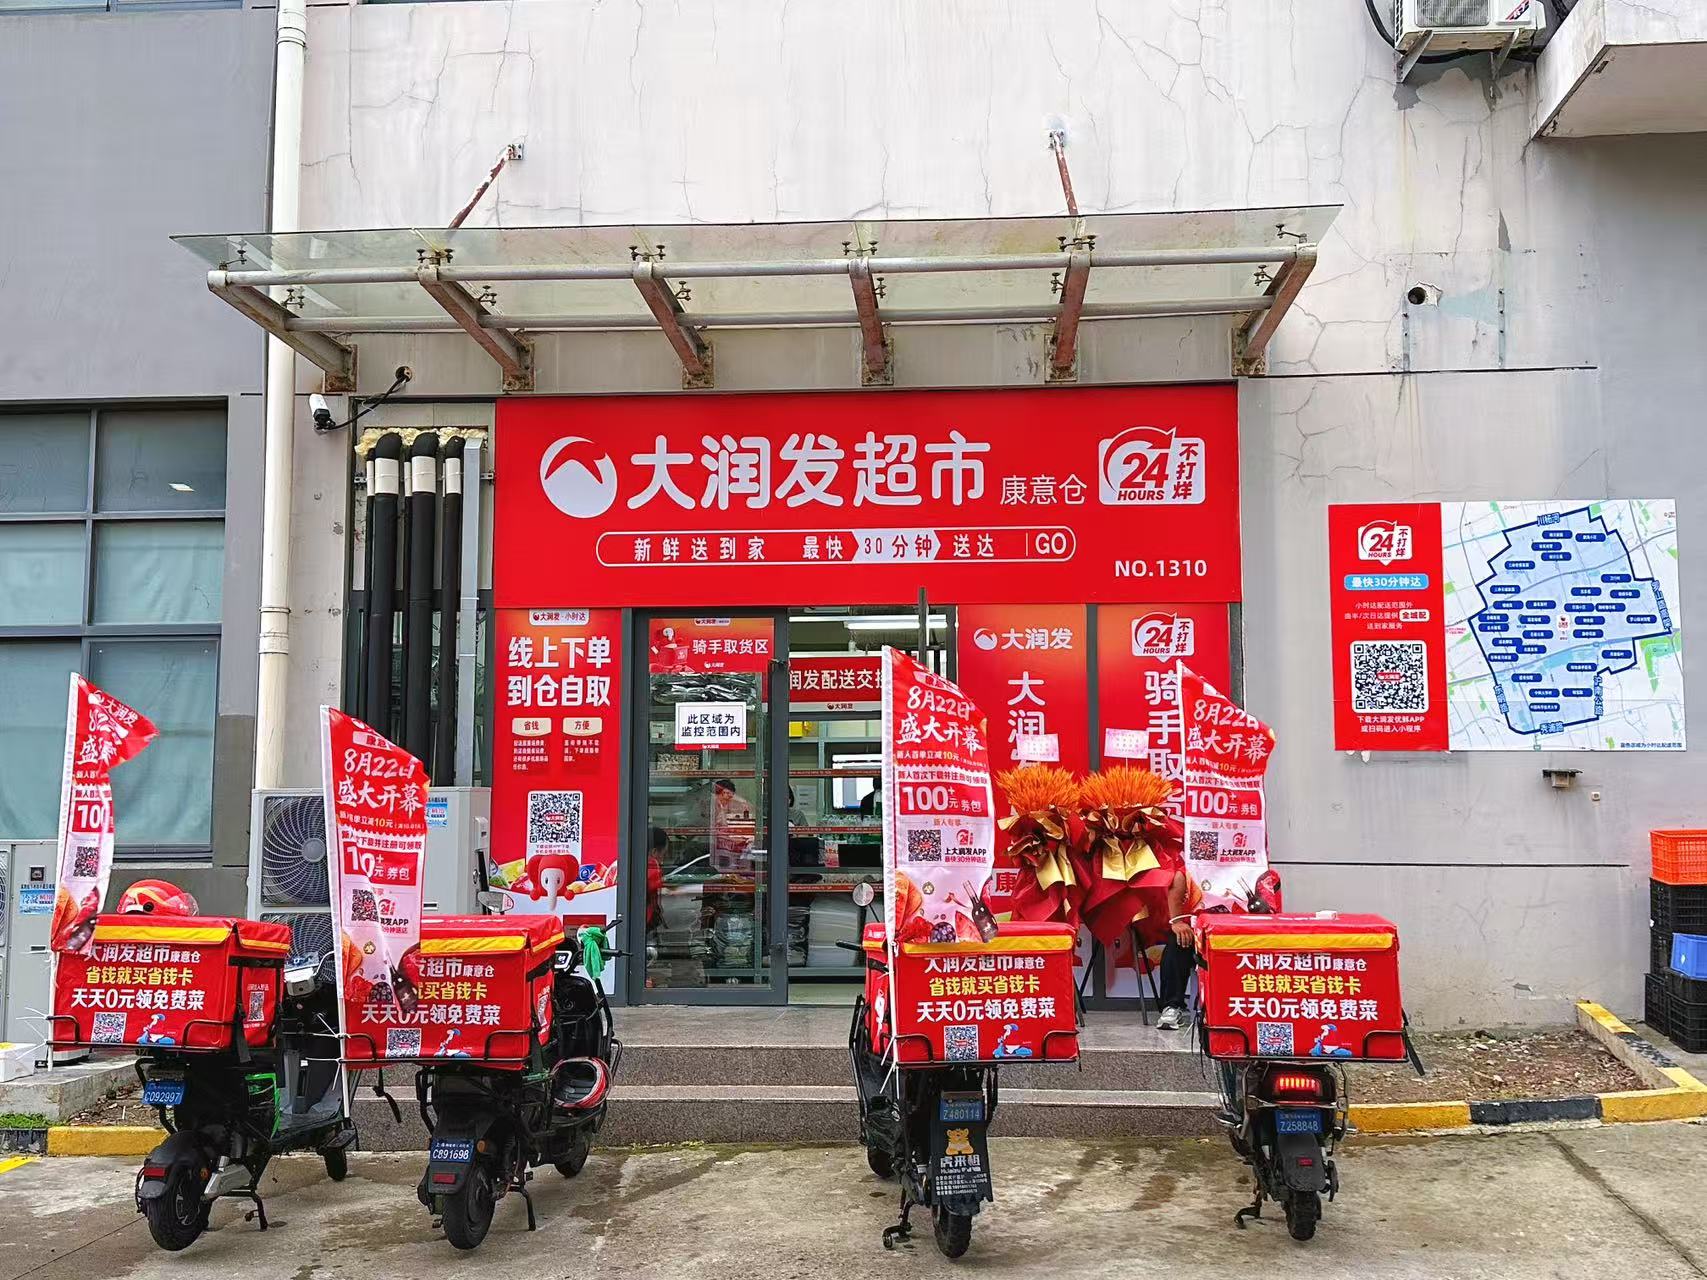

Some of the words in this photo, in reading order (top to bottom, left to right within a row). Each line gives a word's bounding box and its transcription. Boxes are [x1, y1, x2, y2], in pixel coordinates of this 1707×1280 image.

[626, 430, 991, 510] 大润发超市
[1000, 474, 1087, 506] 康意仓
[1120, 451, 1170, 491] 24
[1171, 443, 1199, 500] 不打烊
[1117, 489, 1165, 501] HOURS
[634, 536, 766, 561] 新鲜送到家
[1035, 532, 1067, 555] GO
[1369, 533, 1394, 552] 24
[1395, 528, 1409, 558] 不打烊
[1114, 559, 1207, 577] NO.1310
[1351, 576, 1422, 588] 最快30分钟达
[692, 639, 769, 655] 骑手取货区
[1001, 627, 1073, 650] 大润发
[1143, 626, 1174, 648] 24
[1174, 621, 1190, 653] 不打烊
[508, 636, 611, 669] 线上下单
[507, 674, 611, 707] 到仓自取
[104, 699, 139, 728] 大润发
[907, 685, 970, 721] 8月22日
[1193, 698, 1260, 730] 8月22日
[523, 720, 540, 731] 省钱
[574, 720, 590, 731] 方便
[687, 713, 735, 725] 此区域为
[681, 726, 741, 737] 监控范围内
[895, 712, 985, 758] 盛大开幕
[1186, 722, 1268, 766] 盛大开幕
[336, 774, 424, 819] 盛大开幕
[902, 786, 948, 811] 100
[1187, 789, 1229, 815] 100
[944, 847, 987, 856] 上大润发APP
[86, 966, 193, 986] 省钱就买省钱卡
[929, 975, 1040, 998] 省钱就买省钱卡
[1241, 974, 1362, 996] 省钱就买省钱卡
[71, 988, 206, 1010] 天天0元领免费菜
[916, 996, 1056, 1023] 天天0元领免费菜
[1228, 996, 1379, 1021] 天天0元领免费菜
[144, 1091, 181, 1103] C092997
[432, 1149, 469, 1160] C891698
